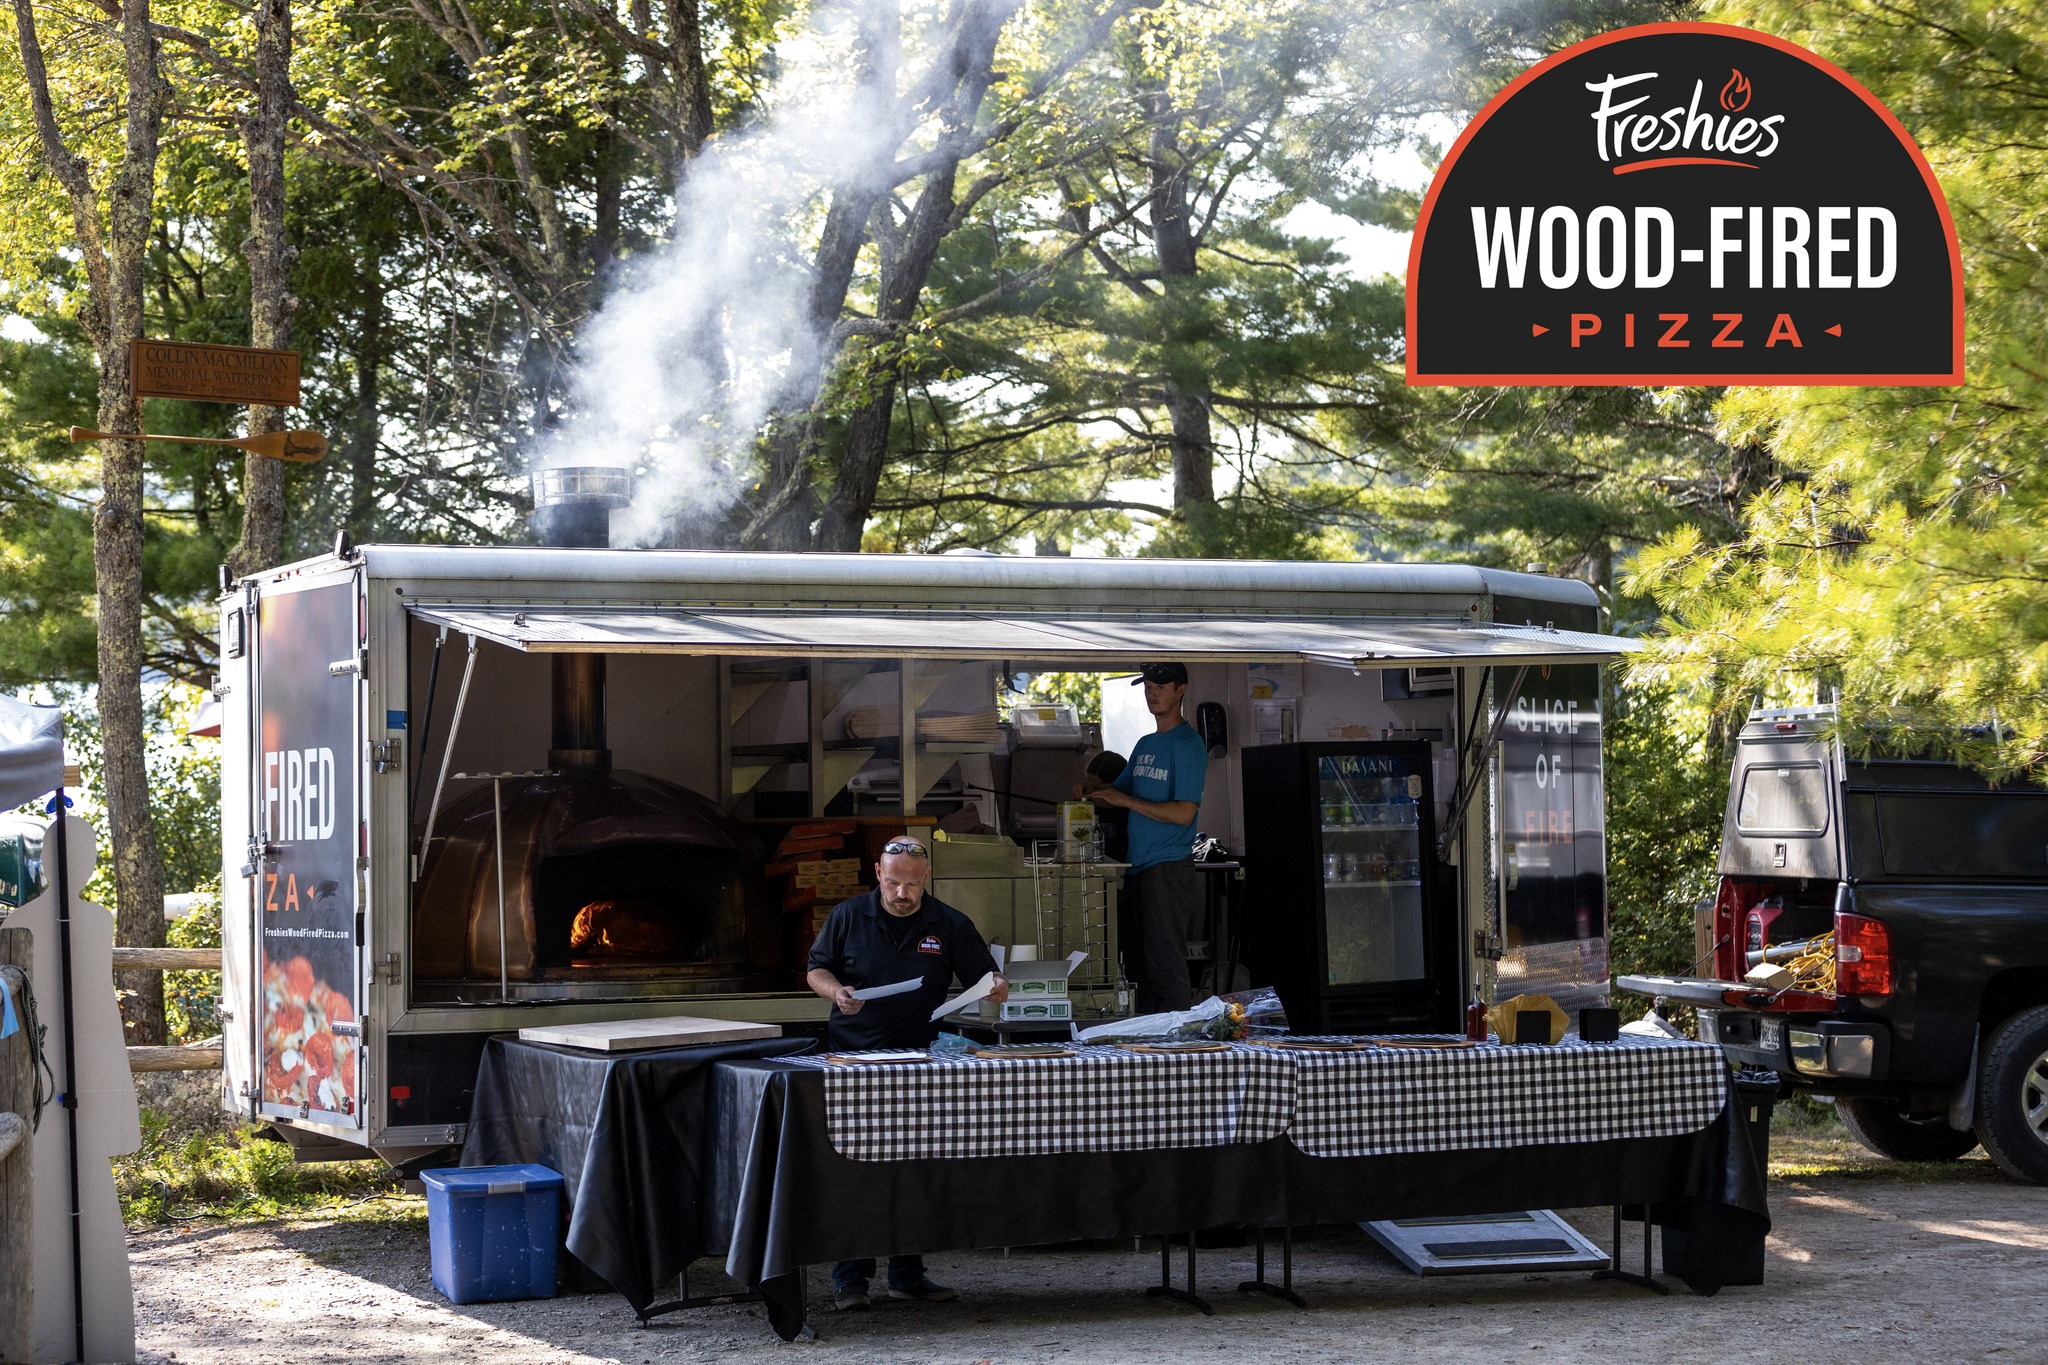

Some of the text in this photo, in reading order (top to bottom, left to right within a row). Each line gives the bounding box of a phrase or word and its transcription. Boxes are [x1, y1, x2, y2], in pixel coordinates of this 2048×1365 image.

[145, 348, 289, 371] COLLIN MACMILLAN
[147, 366, 289, 387] MEMORIAL WATERFRONT
[1517, 696, 1578, 735] SLICE
[1342, 757, 1393, 776] DASANI
[1535, 753, 1561, 789] OF
[1526, 810, 1574, 844] FIRE
[266, 873, 300, 911] ZA
[265, 927, 350, 939] FreshiesWoodFiredPizza.com
